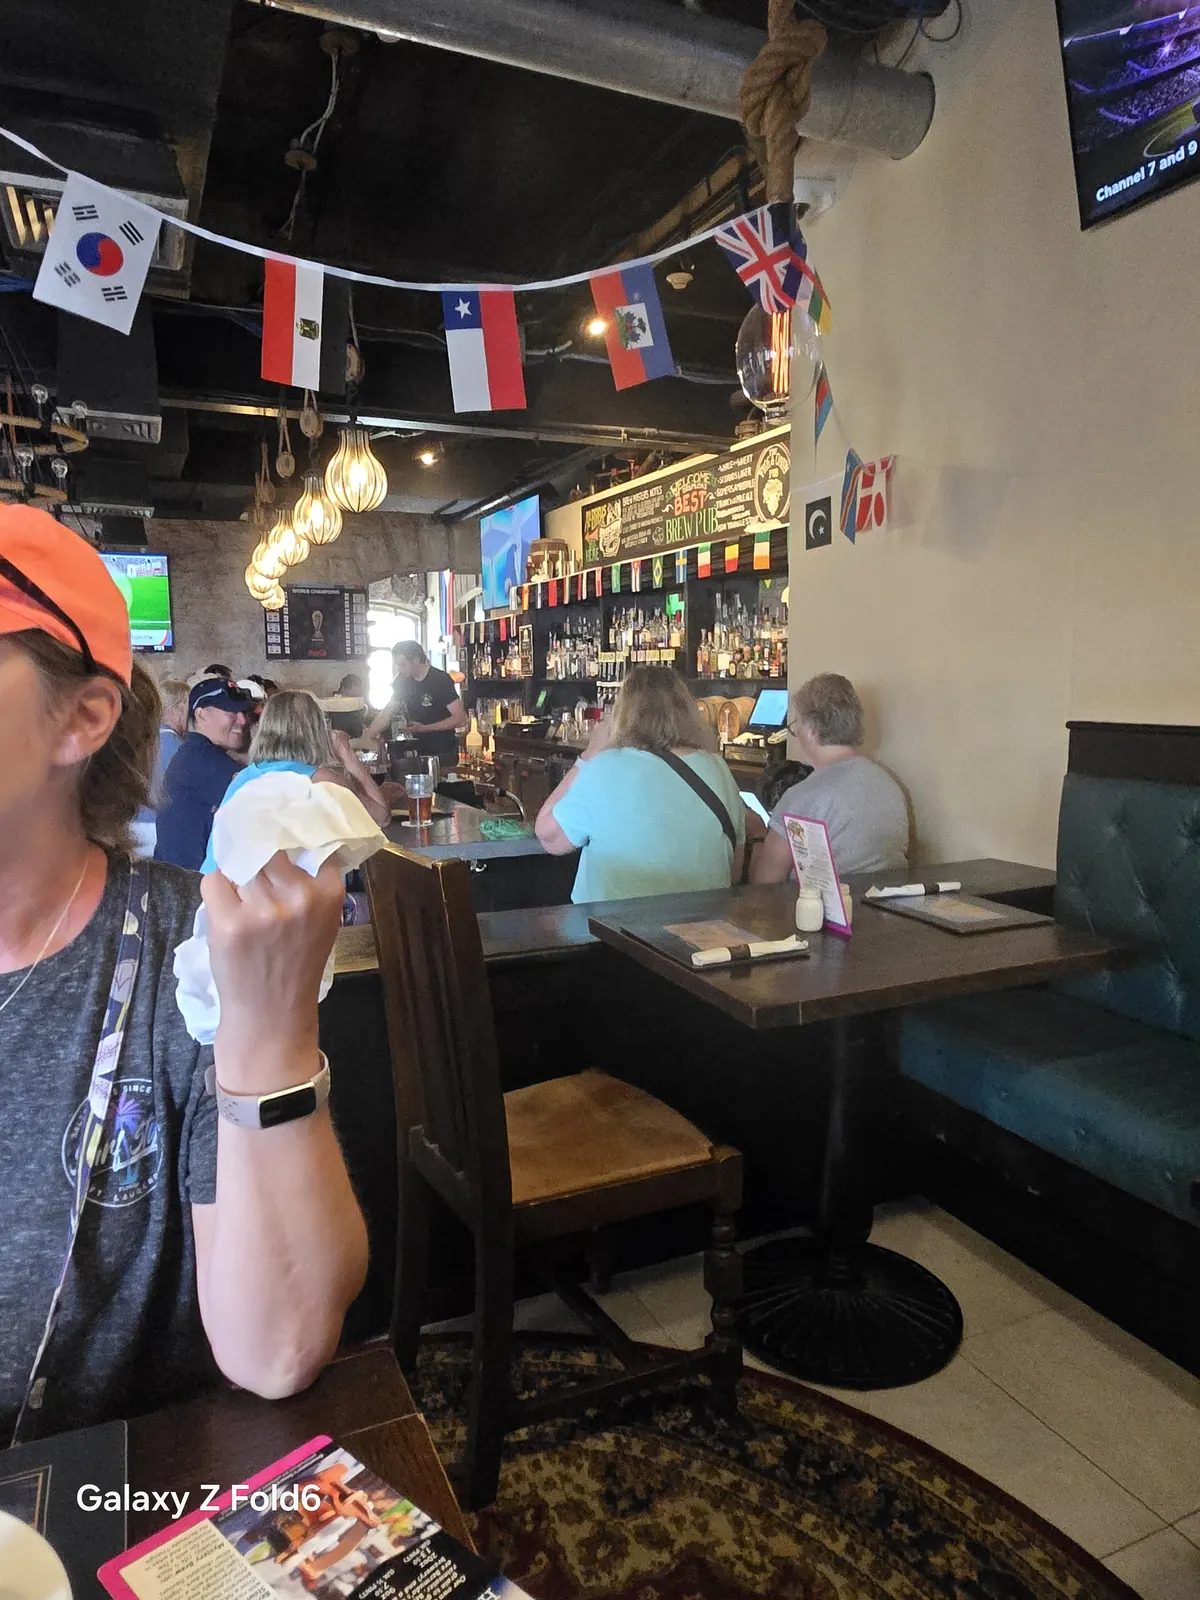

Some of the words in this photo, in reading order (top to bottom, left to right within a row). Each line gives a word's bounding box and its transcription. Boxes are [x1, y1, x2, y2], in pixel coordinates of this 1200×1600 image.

[1096, 166, 1146, 202] Channel
[1147, 161, 1156, 177] 7
[1159, 146, 1186, 171] and
[1187, 140, 1198, 156] 9
[670, 471, 712, 495] WELCOME
[674, 490, 707, 516] BEST
[666, 513, 693, 544] BREW
[696, 507, 718, 537] PUB
[123, 1084, 152, 1094] SINCE
[195, 1542, 224, 1562] Mystery
[419, 1551, 437, 1568] 20oz
[175, 1561, 194, 1575] Brew
[440, 1559, 451, 1571] are
[406, 1569, 441, 1599] Bermuda's
[423, 1564, 457, 1592] rainwater,
[440, 1571, 458, 1589] grain
[453, 1574, 466, 1588] Our
[380, 1586, 396, 1600] 9oz
[403, 1580, 417, 1594] and
[432, 1587, 441, 1596] to
